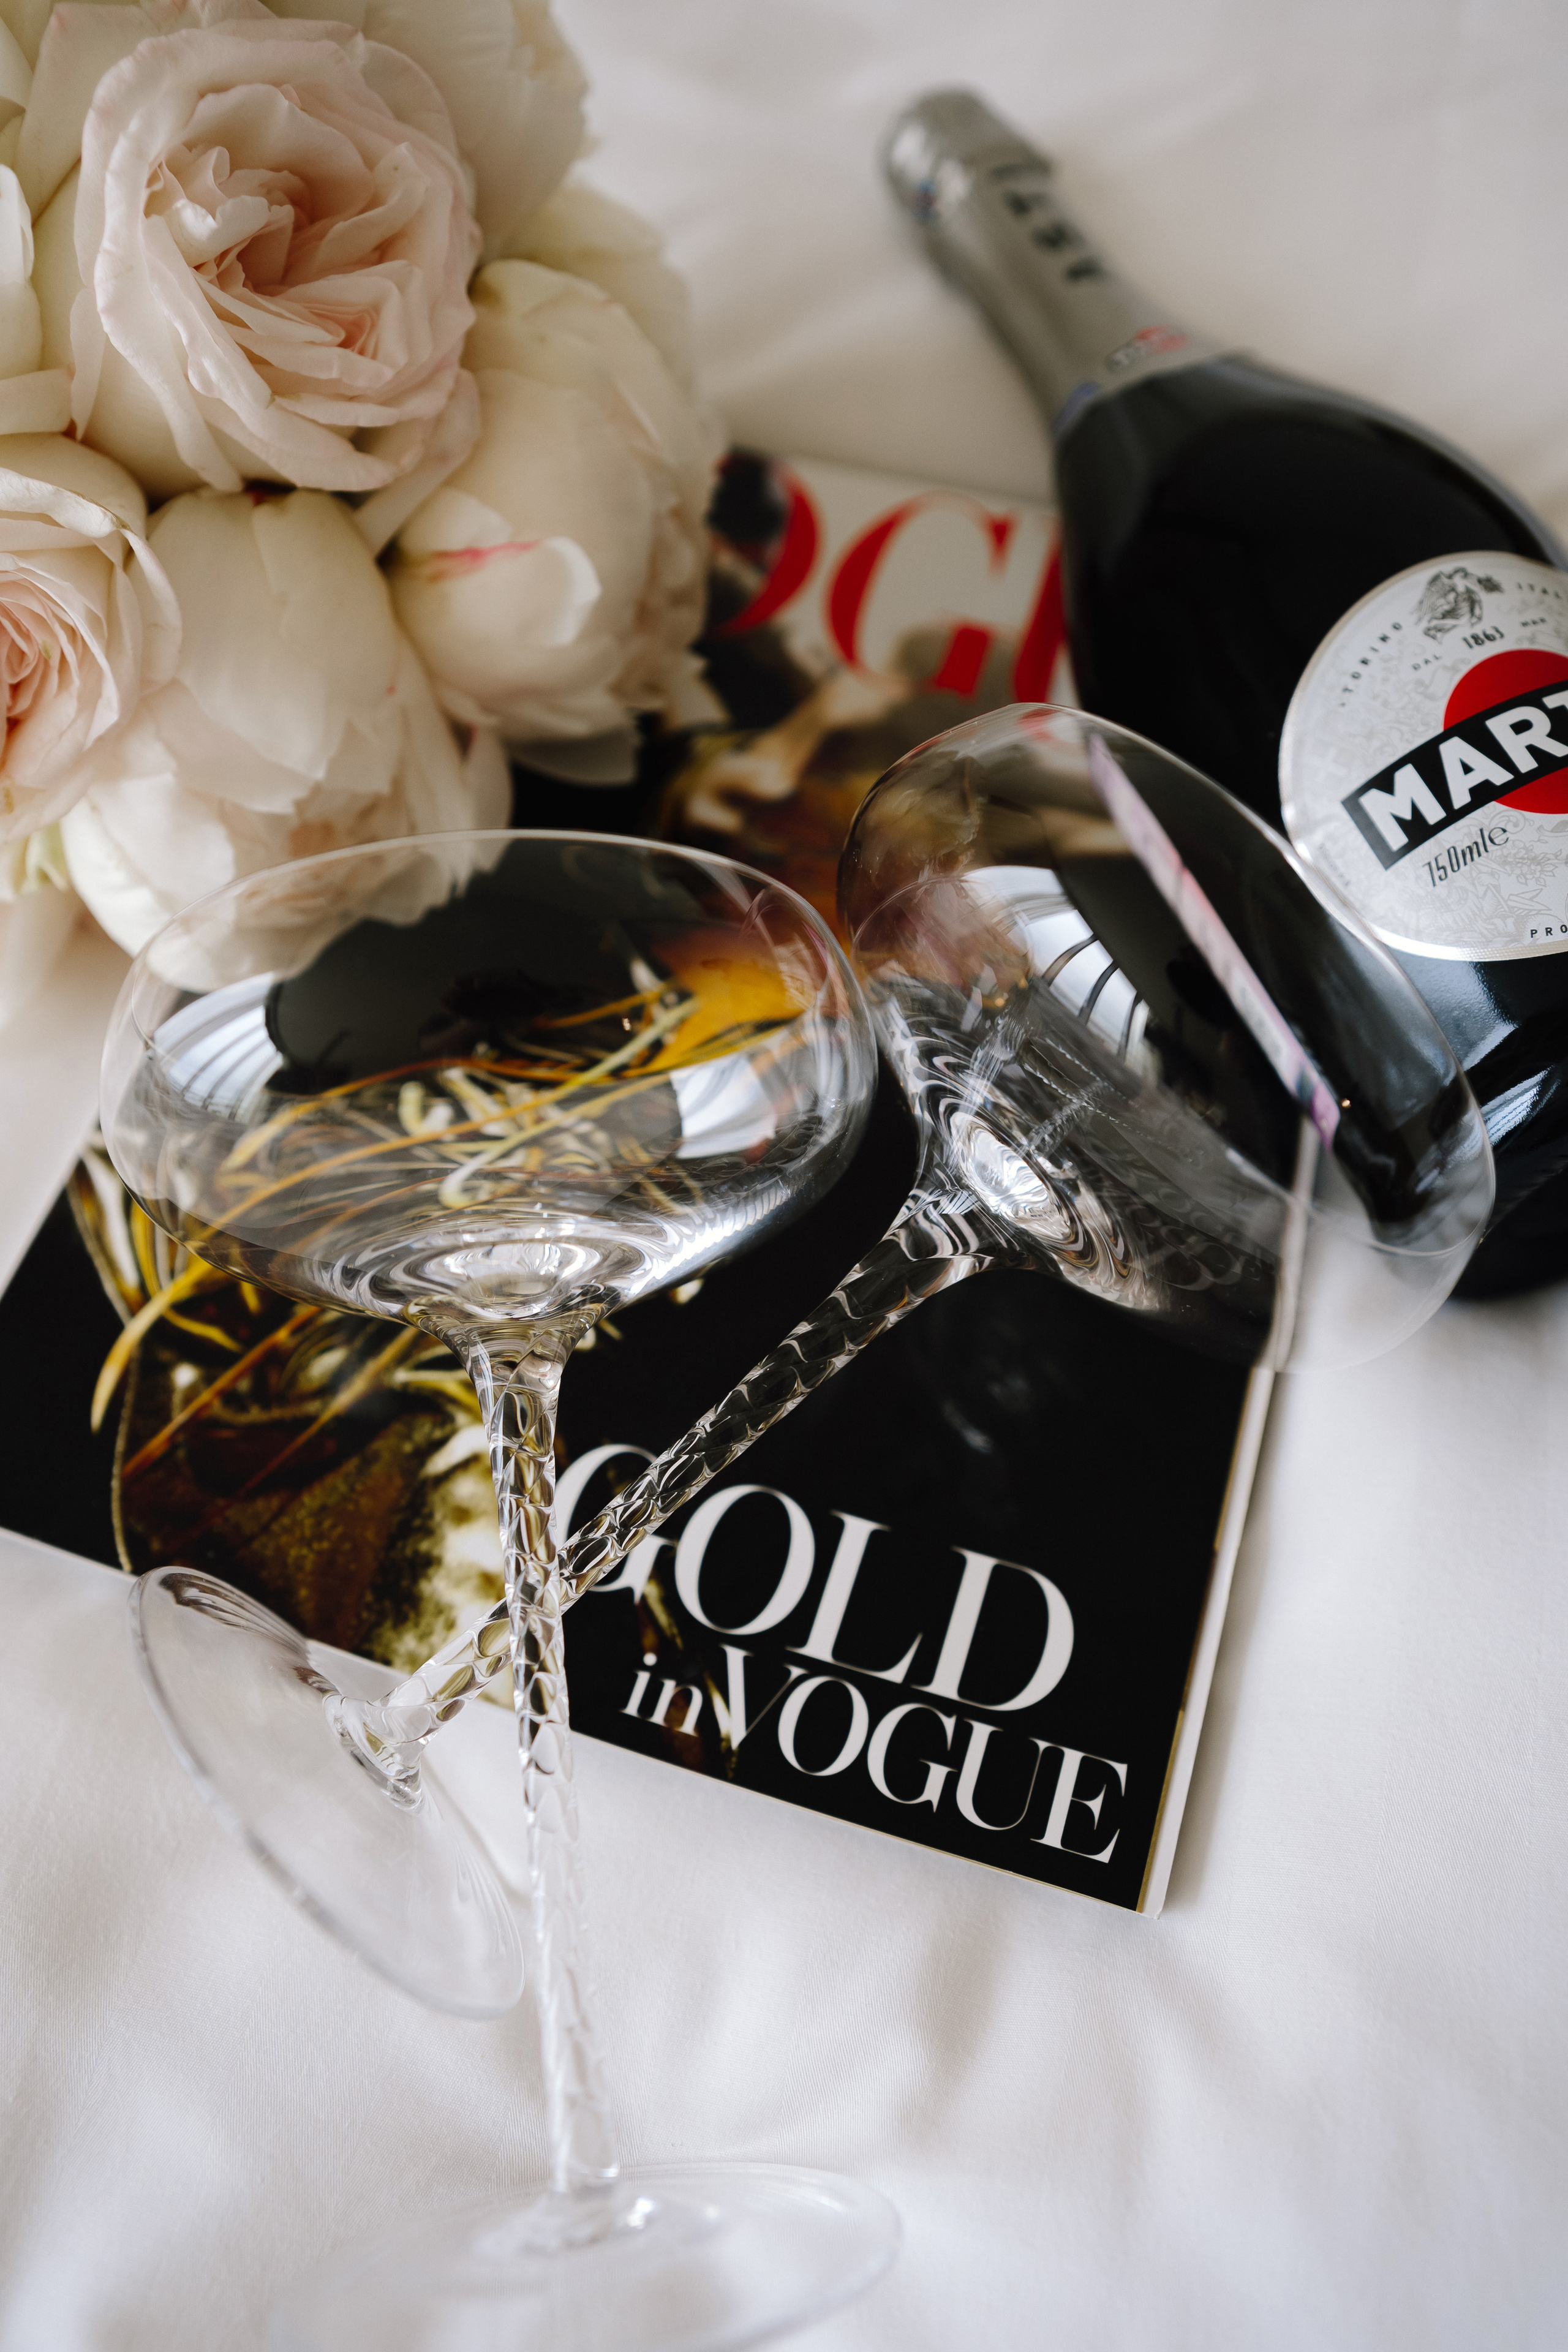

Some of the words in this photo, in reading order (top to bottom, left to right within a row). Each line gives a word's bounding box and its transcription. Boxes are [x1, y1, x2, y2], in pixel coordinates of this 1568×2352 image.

[1342, 622, 1403, 693] TORINO
[1412, 654, 1443, 671] DAL
[1530, 924, 1568, 938] PRO
[554, 1444, 1075, 1711] GOLD
